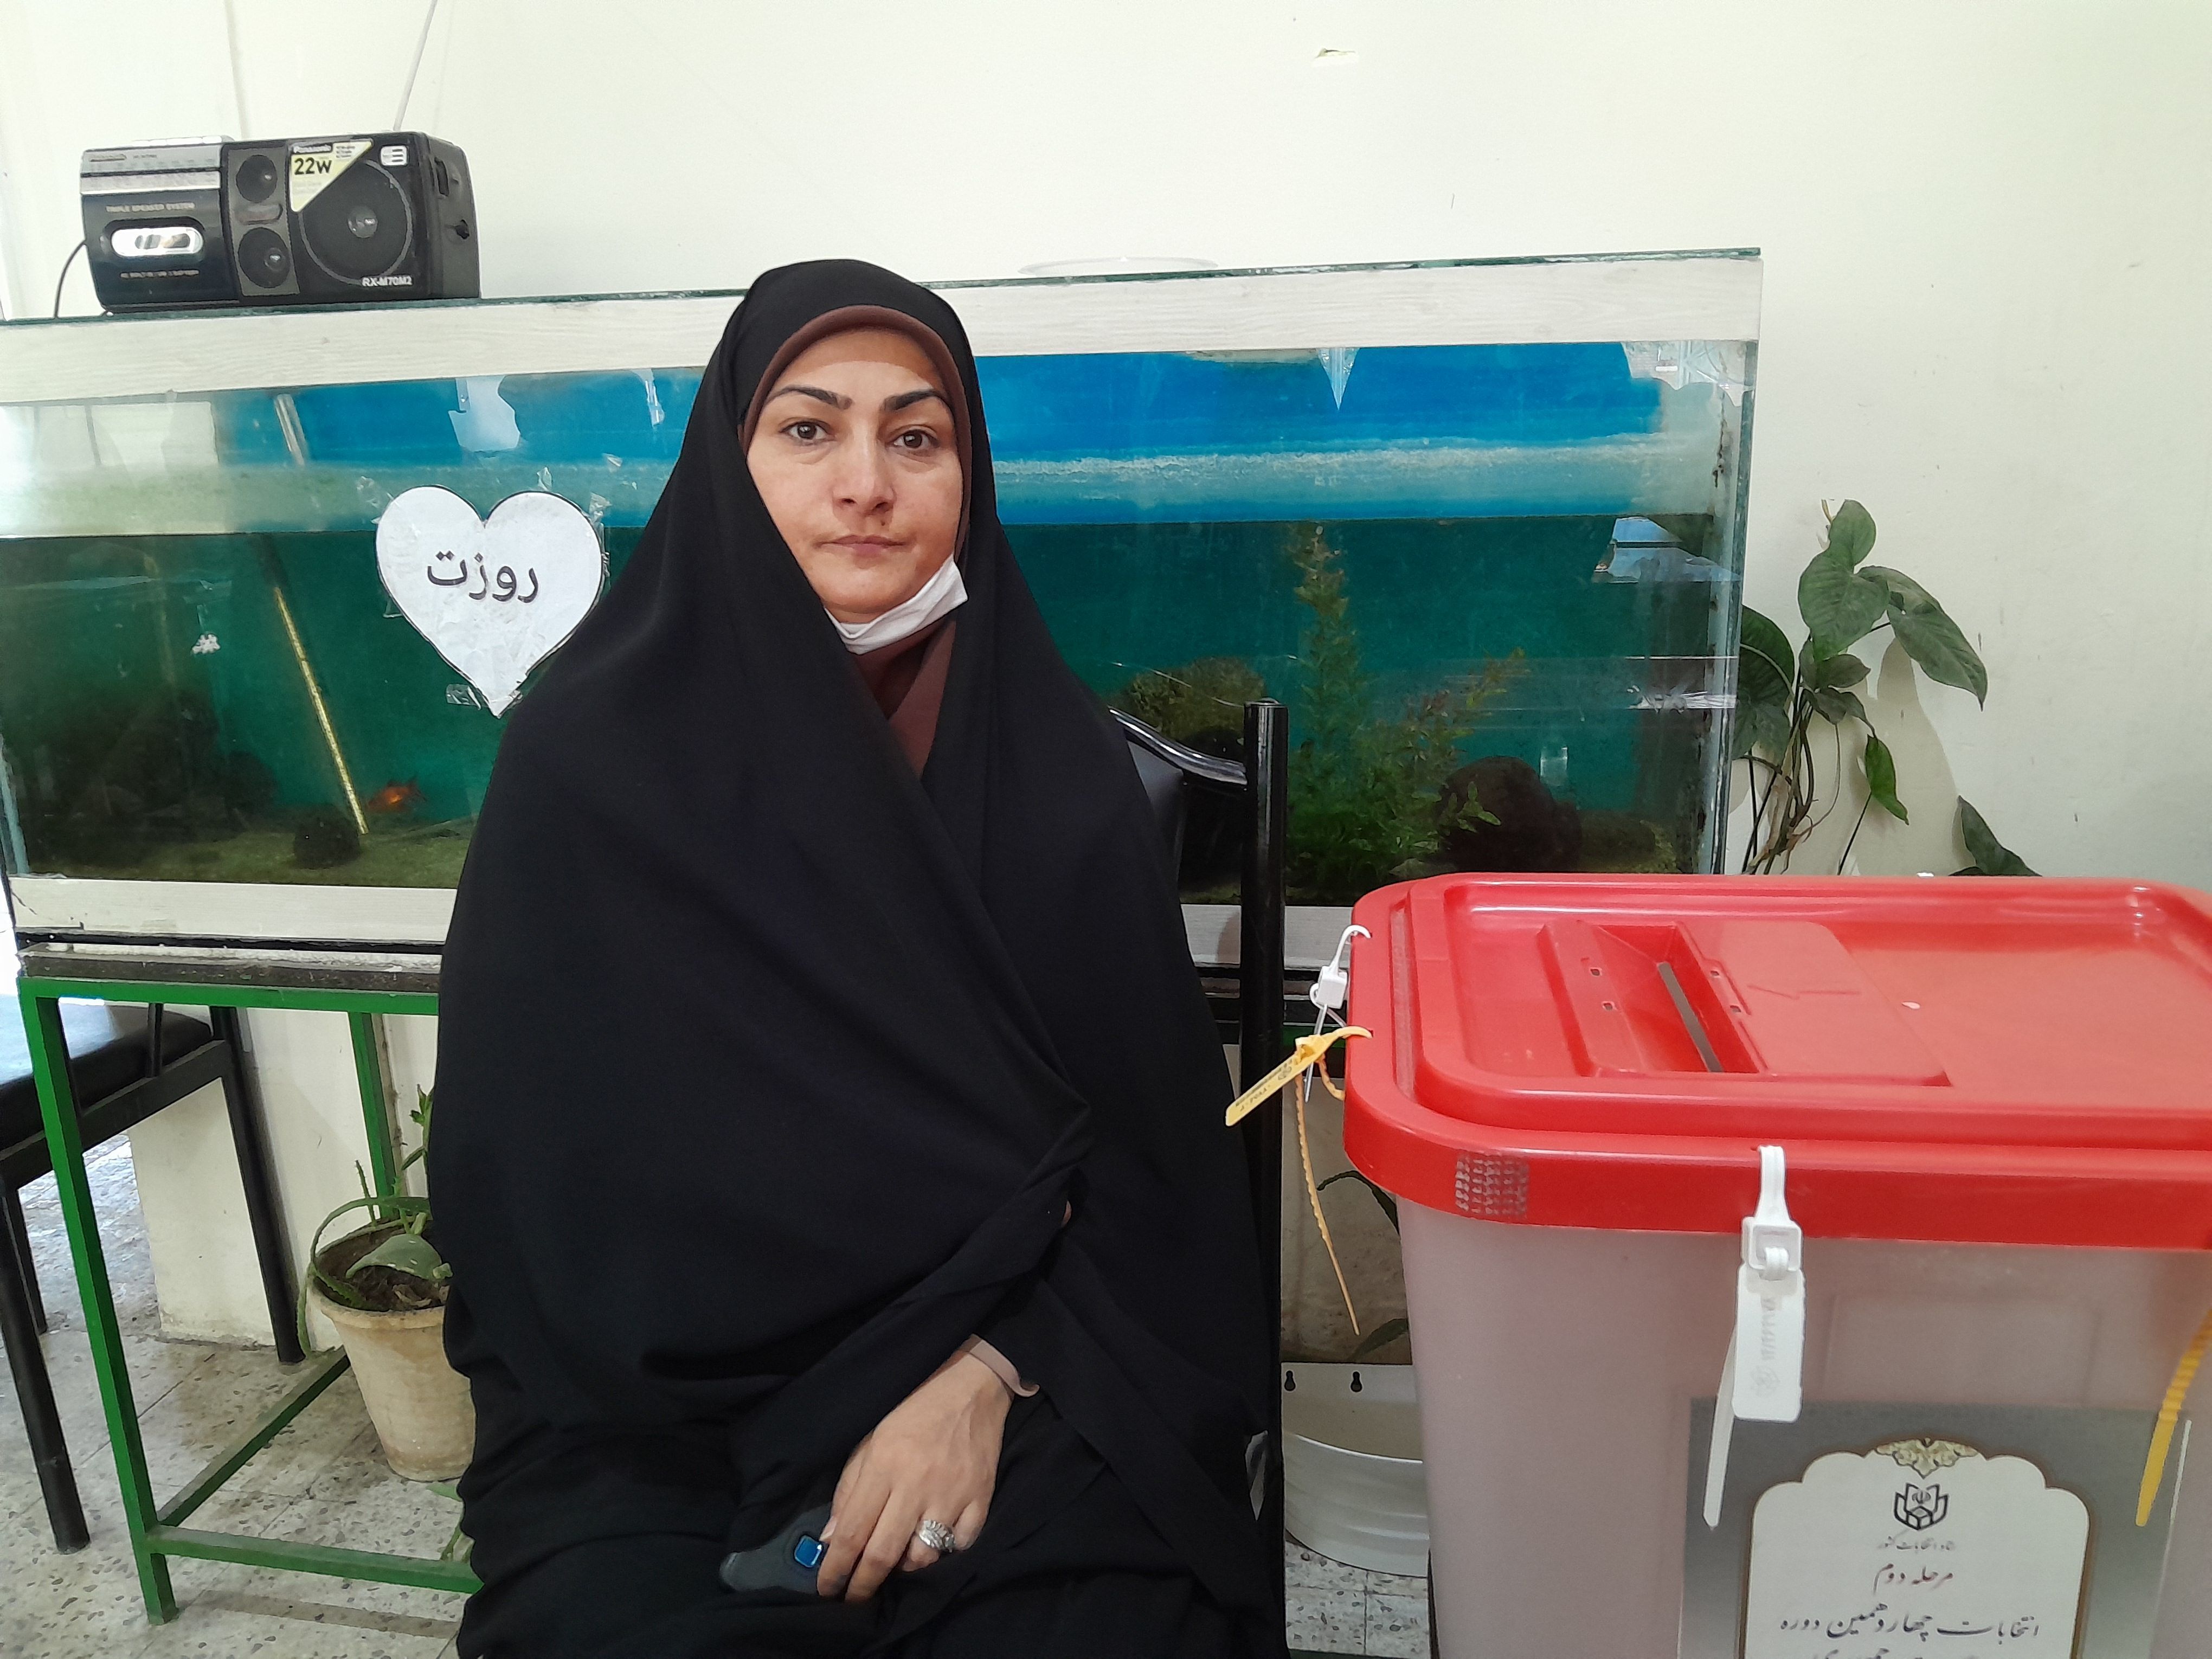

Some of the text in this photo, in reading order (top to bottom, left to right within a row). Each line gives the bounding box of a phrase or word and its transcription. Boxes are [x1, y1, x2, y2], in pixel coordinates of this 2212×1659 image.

[294, 157, 332, 176] 22W
[427, 550, 539, 603] روزت
[1873, 1562, 1953, 1596] مرحله دوم
[1780, 1618, 1821, 1630] دوره
[1937, 1616, 2039, 1645] انتخابات
